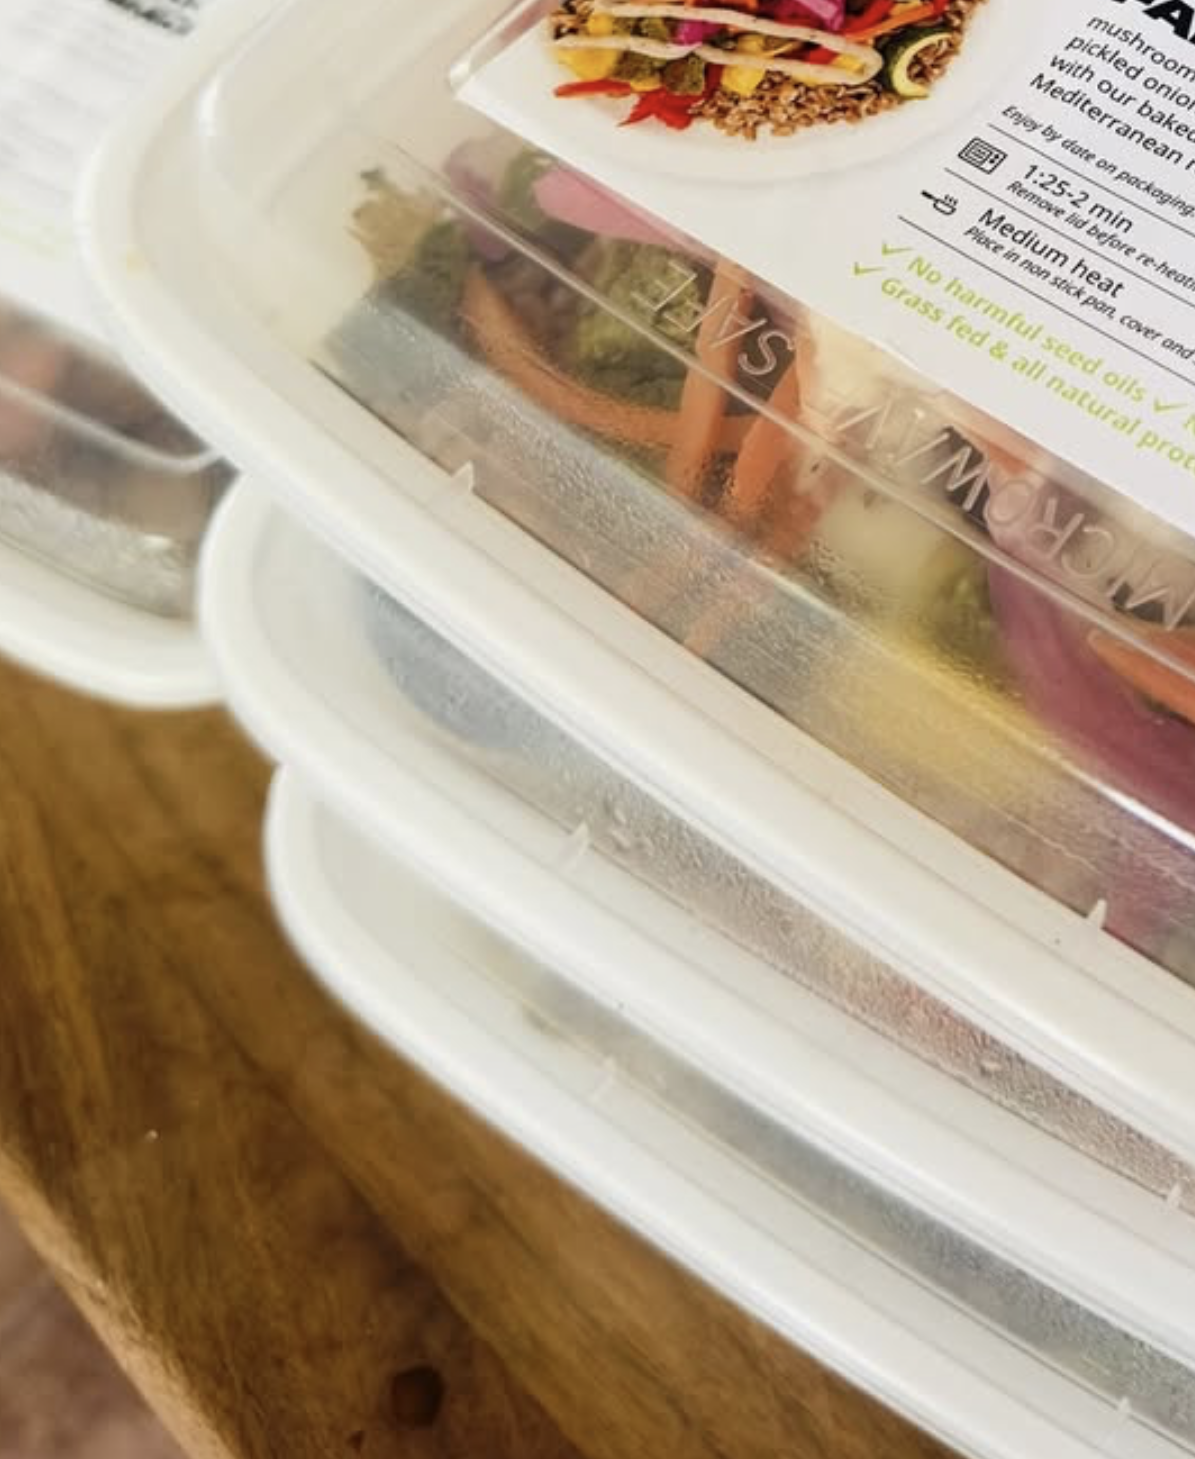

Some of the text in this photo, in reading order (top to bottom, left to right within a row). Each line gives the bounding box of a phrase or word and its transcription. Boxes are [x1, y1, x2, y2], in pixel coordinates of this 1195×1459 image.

[1049, 54, 1095, 83] with
[1096, 79, 1137, 106] our
[1064, 36, 1145, 81] pickled
[1001, 105, 1044, 133] Enjoy
[1040, 124, 1063, 143] by
[1060, 138, 1097, 163] date
[1095, 158, 1118, 175] on
[1113, 170, 1195, 218] packaging.
[1029, 72, 1184, 165] Mediterranean
[1006, 180, 1066, 218] Remove
[1063, 212, 1091, 230] lid
[1085, 223, 1137, 257] before
[1024, 164, 1133, 234] 1:25-2 min
[963, 225, 1005, 254] Place
[1002, 247, 1021, 264] in
[1018, 258, 1052, 281] non
[1049, 276, 1086, 300] stick
[1079, 295, 1117, 320] pan,
[1119, 315, 1163, 341] cover
[978, 208, 1125, 299] Medium heat
[880, 277, 945, 324] Grass
[945, 314, 991, 348] fed
[988, 340, 1009, 362] &
[1010, 356, 1048, 382] all
[1046, 375, 1143, 437] natural
[907, 255, 943, 286] No
[943, 277, 1044, 342] harmful
[1040, 335, 1104, 376] seed
[1101, 371, 1147, 404] oils
